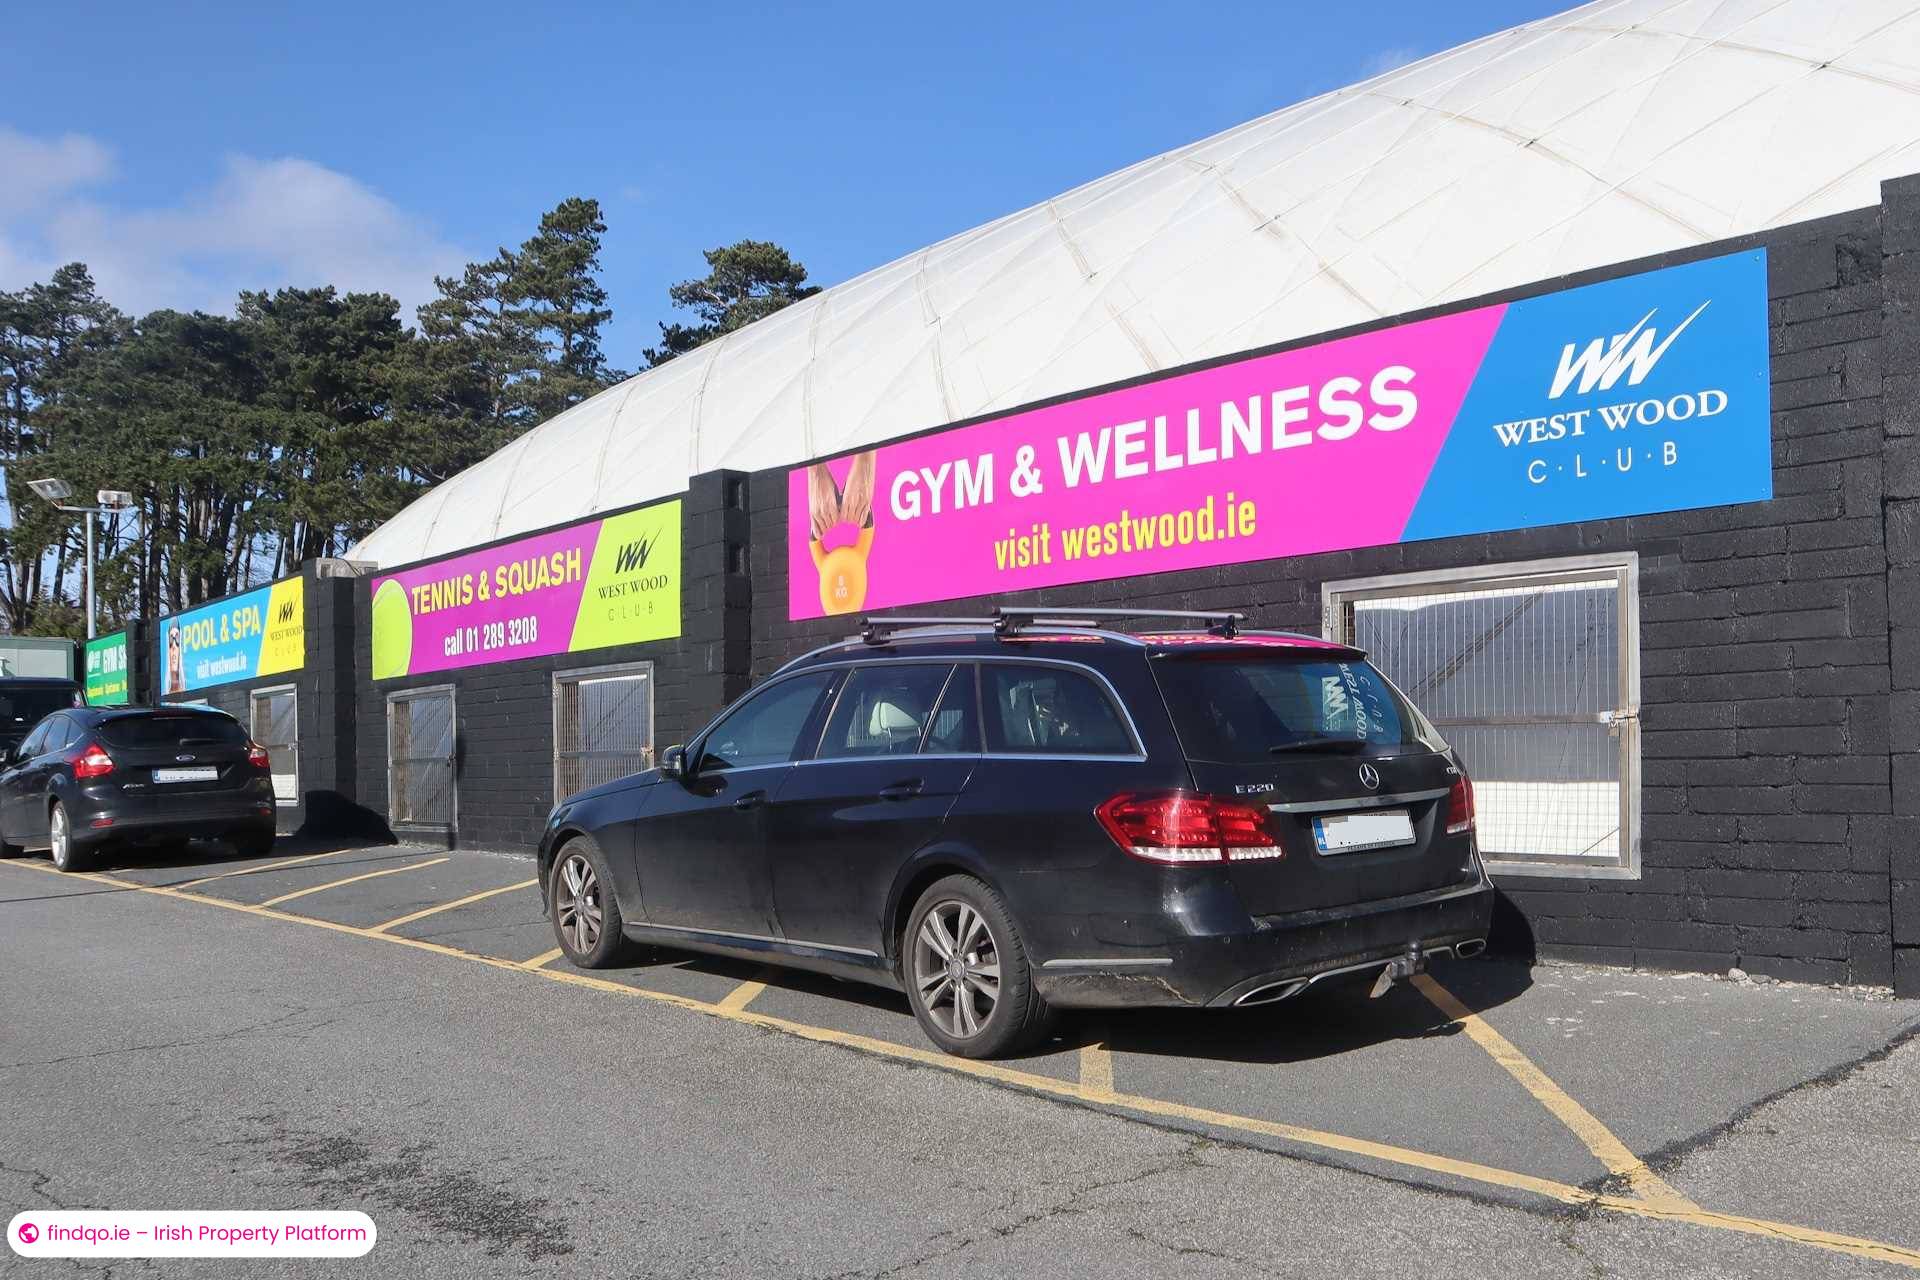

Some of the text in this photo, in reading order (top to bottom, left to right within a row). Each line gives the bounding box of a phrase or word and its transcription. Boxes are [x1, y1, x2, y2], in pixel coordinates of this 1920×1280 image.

[890, 365, 1418, 520] GYM & WELLNESS
[1493, 389, 1728, 447] WEST WOOD
[995, 492, 1256, 571] visit westwood.ie
[412, 548, 581, 615] TENNIS & SQUASH
[598, 573, 669, 600] WEST WOOD
[183, 604, 261, 653] POOL & SPA
[444, 616, 538, 656] call 01 289 3208
[1235, 783, 1274, 794] E 220
